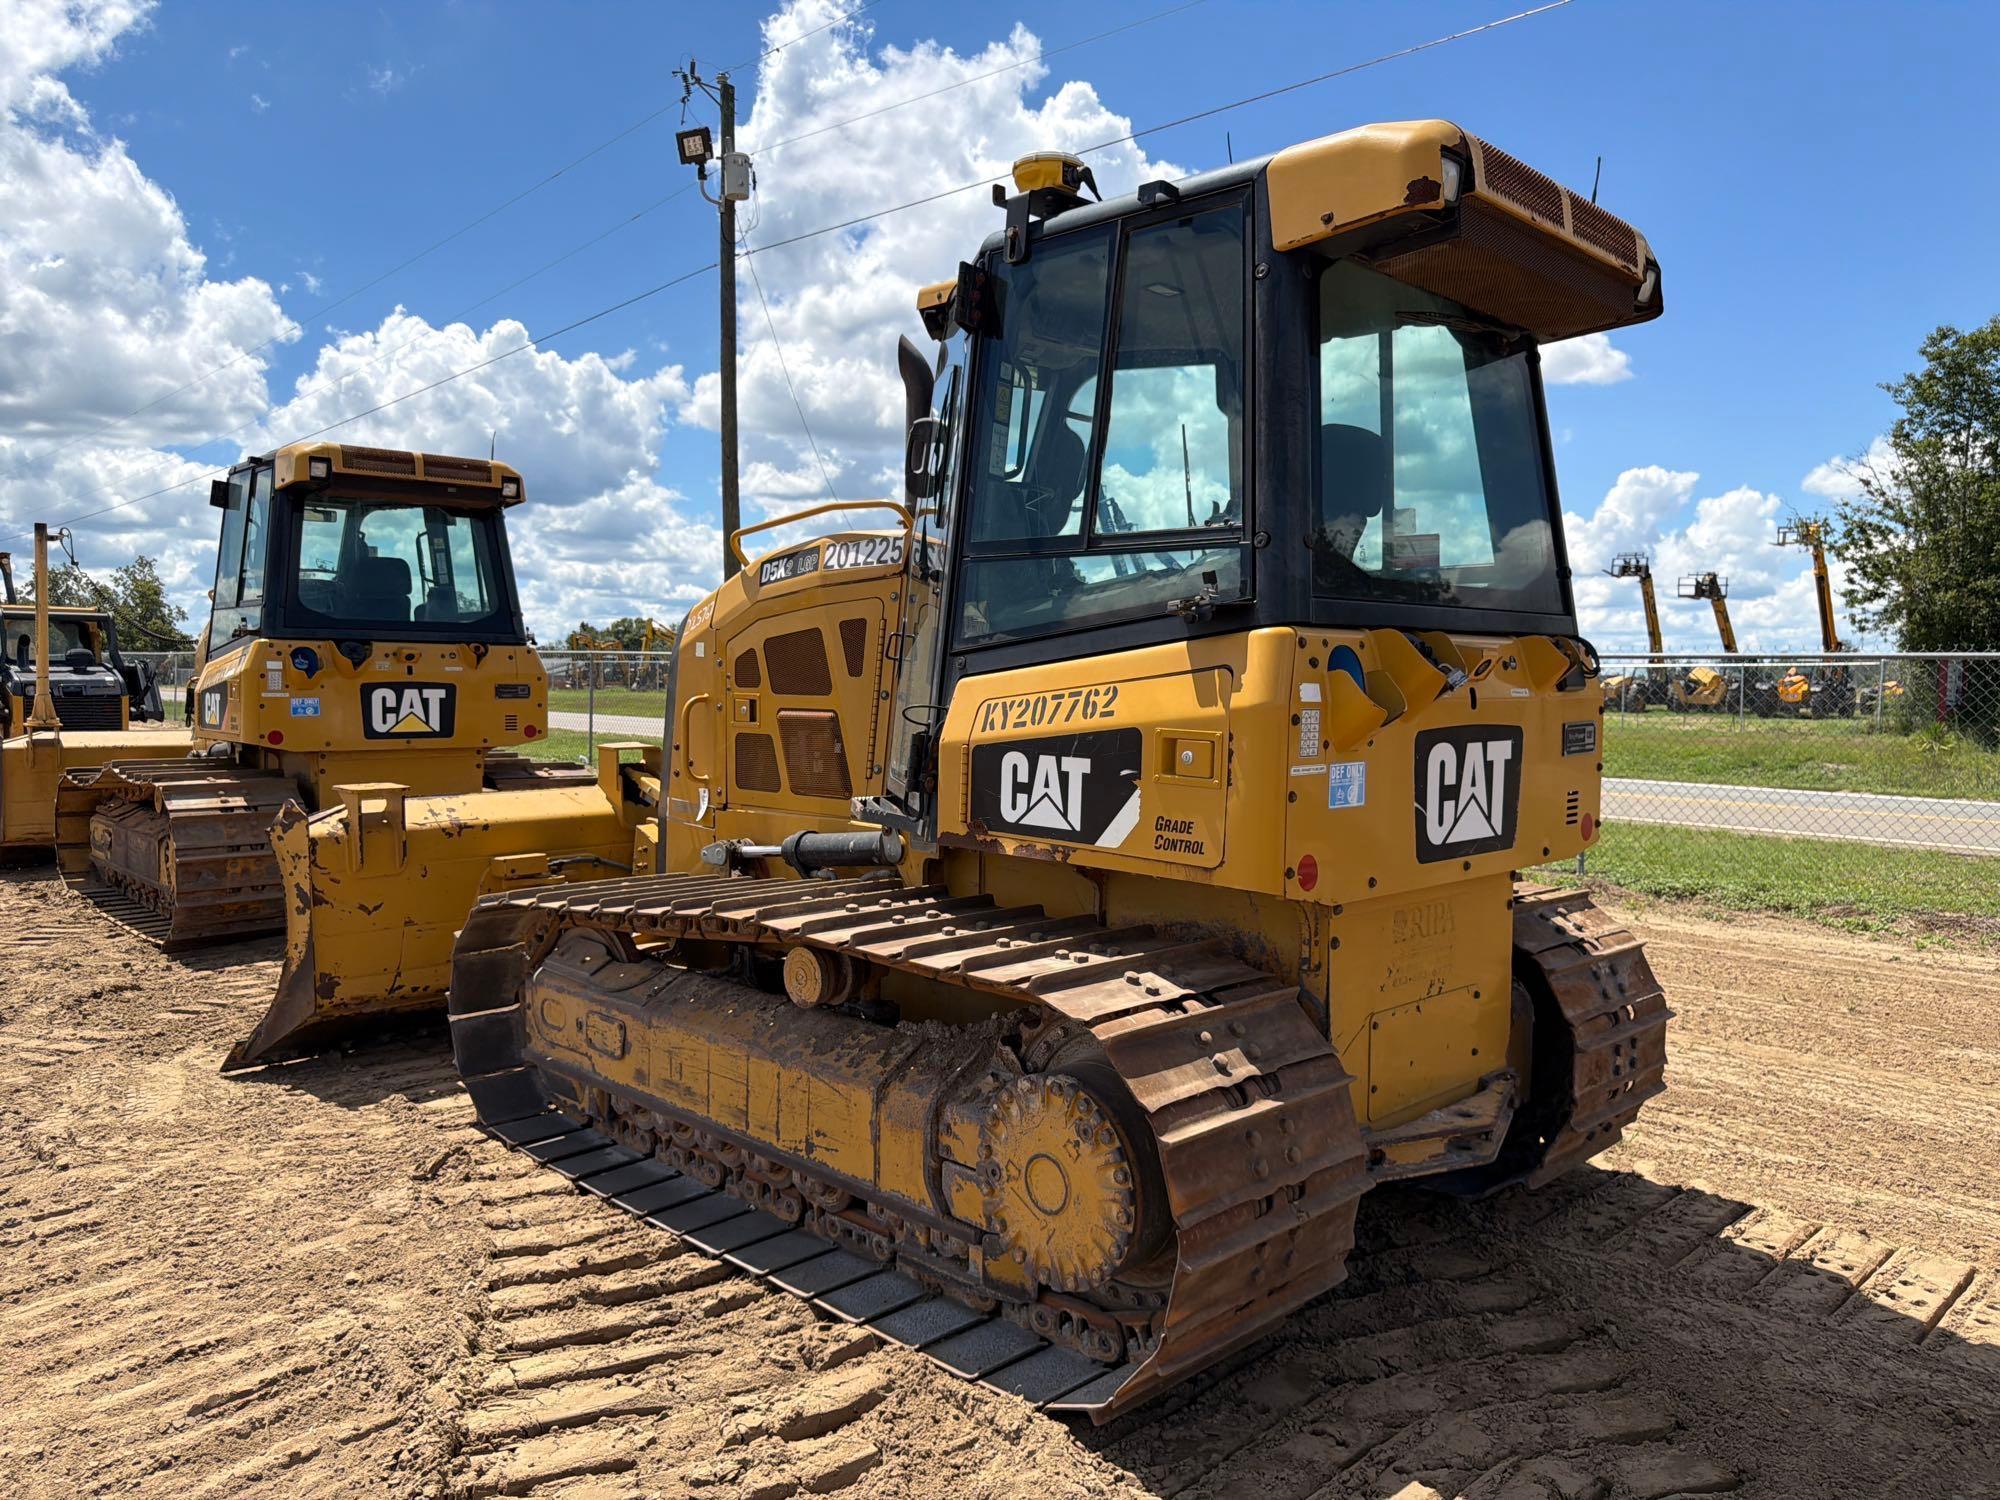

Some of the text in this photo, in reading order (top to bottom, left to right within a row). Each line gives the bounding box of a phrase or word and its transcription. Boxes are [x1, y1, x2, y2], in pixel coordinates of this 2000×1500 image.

[824, 538, 903, 569] 201225
[205, 692, 221, 725] CAT
[371, 688, 446, 733] CAT
[980, 685, 1119, 732] KY207762
[1331, 766, 1344, 778] DEF
[1000, 751, 1091, 832] CAT
[1426, 739, 1513, 845] CAT
[1154, 815, 1194, 836] GRADE
[1154, 834, 1205, 856] CONTROL
